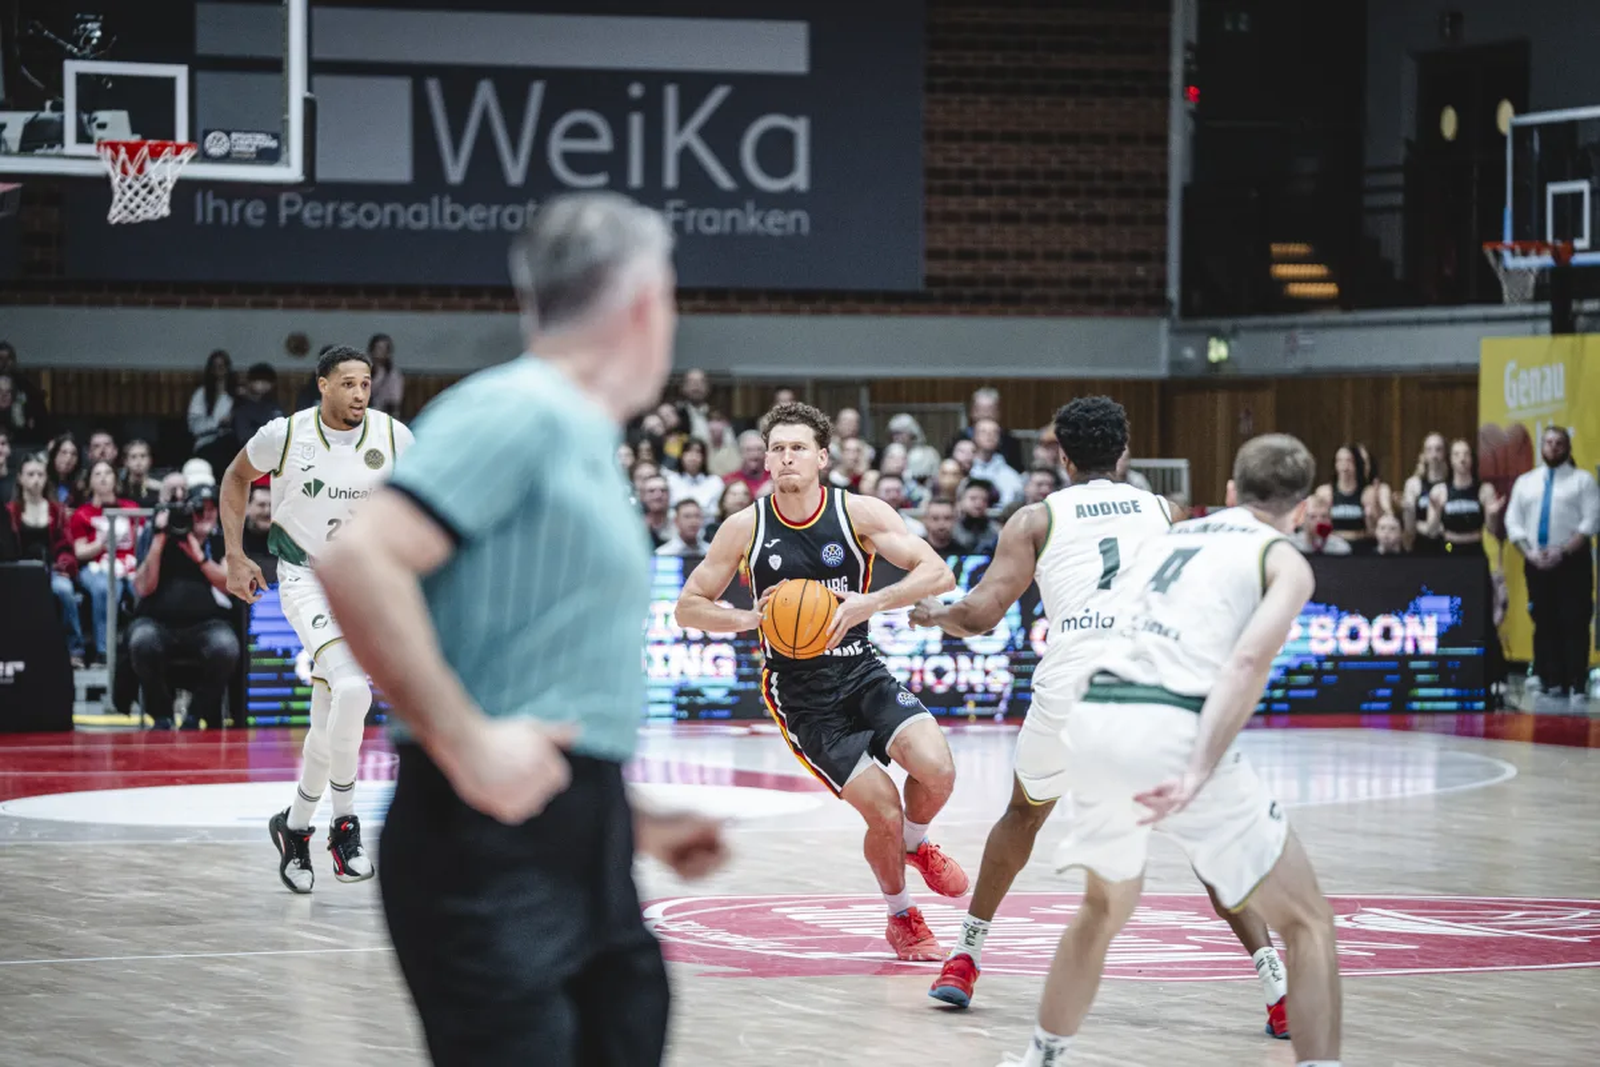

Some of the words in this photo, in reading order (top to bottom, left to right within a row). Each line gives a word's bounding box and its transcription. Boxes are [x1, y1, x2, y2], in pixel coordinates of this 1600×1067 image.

[426, 77, 811, 192] WeiKa
[194, 190, 268, 228] Ihre
[279, 192, 541, 232] Personalberat
[664, 199, 811, 236] Franken
[1504, 359, 1565, 410] Genau
[1075, 500, 1142, 518] AUDIGE
[1096, 537, 1121, 590] 1
[1308, 613, 1438, 655] SOON
